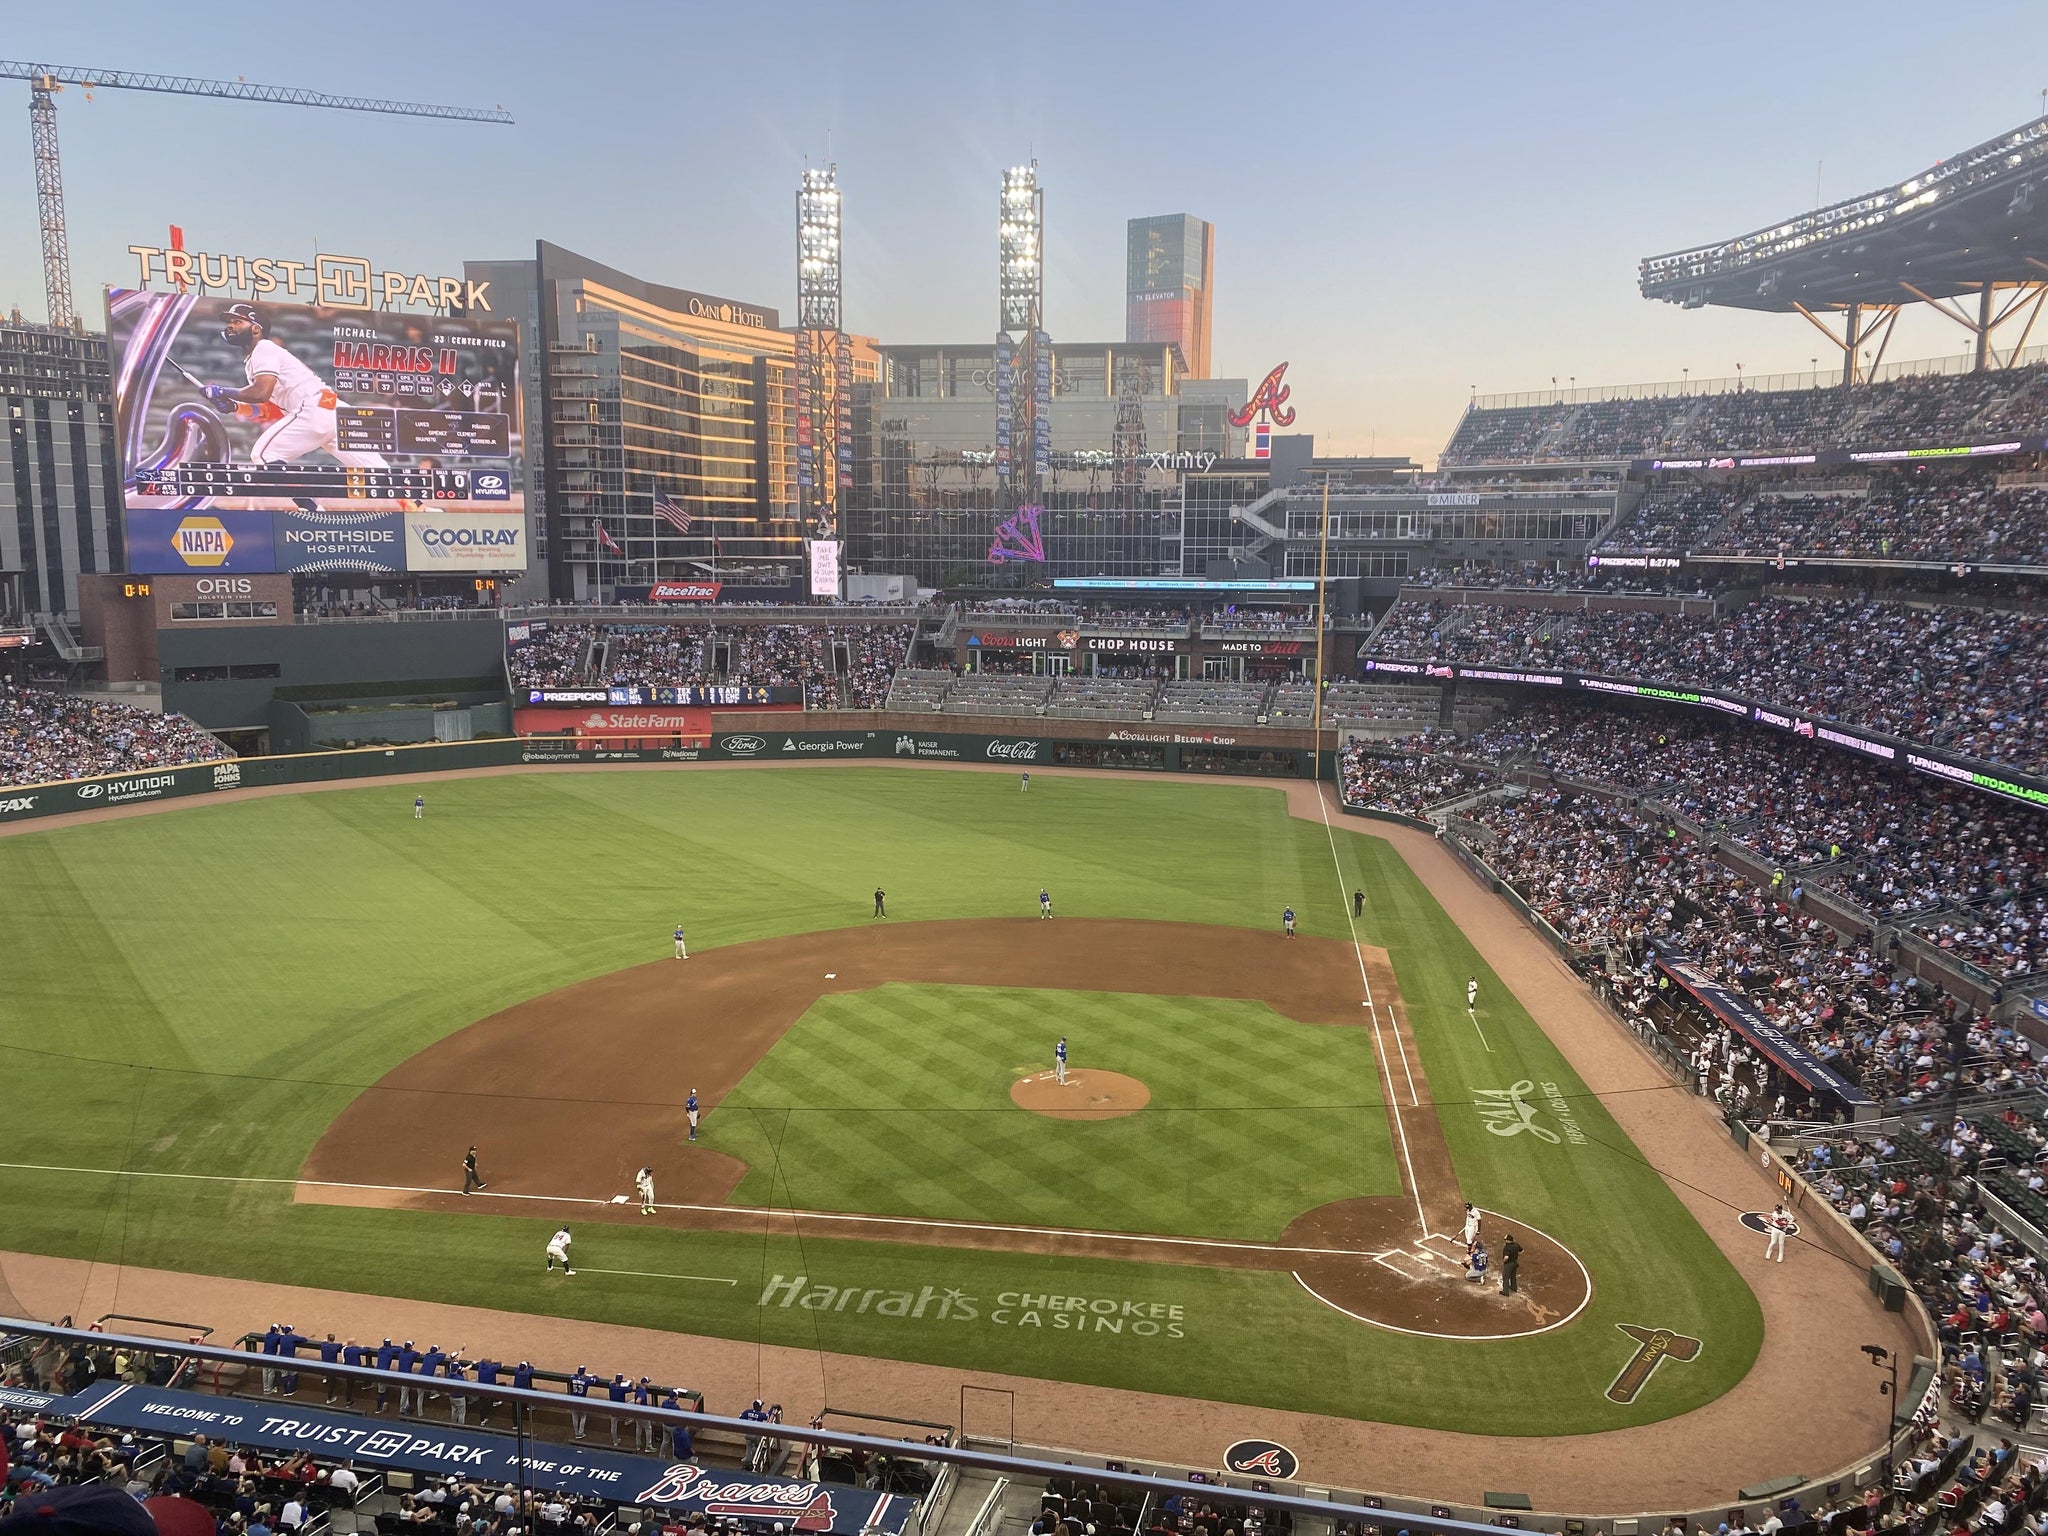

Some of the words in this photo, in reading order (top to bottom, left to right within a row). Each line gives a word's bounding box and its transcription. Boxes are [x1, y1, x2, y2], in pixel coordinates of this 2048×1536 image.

[128, 245, 305, 296] TRUIST
[383, 270, 493, 312] PARK
[1145, 291, 1175, 301] ELEVATOR
[333, 326, 378, 339] MICHAEL
[434, 336, 445, 344] 23
[451, 336, 482, 346] CENTER
[484, 339, 506, 348] FIELD
[333, 341, 433, 374] HARRIS
[438, 348, 457, 375] II
[1908, 449, 1929, 458] INTO
[1929, 447, 1971, 456] DOLLARS
[1150, 450, 1217, 473] xfinity
[1661, 460, 1703, 469] PRIZEPICKS
[187, 472, 193, 481] 1
[205, 473, 213, 482] 0
[226, 473, 232, 482] 1
[244, 473, 251, 482] 0
[353, 476, 359, 485] 2
[370, 476, 377, 485] 5
[388, 477, 393, 485] 1
[404, 477, 411, 486] 4
[422, 477, 426, 486] 1
[440, 475, 446, 487] 1
[454, 475, 465, 488] 0
[187, 486, 195, 495] 0
[208, 486, 213, 495] 1
[226, 486, 233, 496] 3
[353, 488, 360, 497] 4
[370, 489, 378, 498] 6
[388, 489, 394, 498] 0
[404, 489, 411, 498] 3
[421, 489, 428, 498] 2
[475, 488, 507, 496] HYUNDAI
[1438, 494, 1478, 505] MILNER
[182, 531, 224, 552] NAPA
[285, 530, 394, 543] NORTHSIDE
[422, 528, 519, 546] COOLRAY
[307, 544, 376, 554] HOSPITAL
[1598, 557, 1646, 567] PRIZEPICKS
[1667, 559, 1680, 568] PM
[196, 578, 251, 594] ORIS
[655, 584, 713, 597] RaceTrac
[981, 632, 1015, 647] Coors
[1015, 638, 1047, 647] LIGHT
[1088, 638, 1124, 650] CHOP
[1129, 639, 1175, 651] HOUSE
[1222, 643, 1248, 651] MADE
[1249, 643, 1262, 652] TO
[1263, 640, 1300, 655] Chill
[1375, 662, 1418, 674] PRIZEPICKS
[543, 692, 607, 701] PRIZEPICKS
[611, 691, 627, 701] NL
[1579, 679, 1603, 690] TURN
[1602, 682, 1638, 694] DINGERS
[1638, 686, 1658, 696] INTO
[1658, 689, 1700, 702] DOLLARS
[1760, 711, 1790, 728] PRIZEPICKS
[728, 737, 758, 750] Ford
[1119, 729, 1146, 742] Coors
[1145, 735, 1170, 743] LIGHT
[1174, 734, 1204, 744] BELOW
[1213, 736, 1236, 745] CHOP
[798, 741, 834, 752] Georgia
[836, 740, 864, 750] Power
[918, 748, 958, 757] PERMANENTE
[986, 739, 1040, 760] Coca-Cola
[670, 750, 700, 759] National
[213, 763, 240, 776] PAPA
[107, 775, 175, 794] HYUNDAI
[213, 772, 241, 784] JOHNS
[1906, 754, 1932, 770] TURN
[1931, 760, 1973, 782] DINGERS
[1973, 773, 1998, 788] INTO
[1997, 780, 2048, 805] DOLLARS
[108, 789, 162, 802] HyundaiUSA.com
[995, 1290, 1185, 1322] CHEROKEE
[990, 1308, 1186, 1339] CASINOS
[141, 1402, 218, 1424] WELCOME
[221, 1413, 245, 1427] TO
[257, 1416, 367, 1446] TRUIST
[404, 1439, 494, 1466] PARK
[505, 1453, 559, 1473] HOME
[559, 1464, 583, 1477] OF
[586, 1466, 622, 1483] THE
[634, 1463, 820, 1503] Braves
